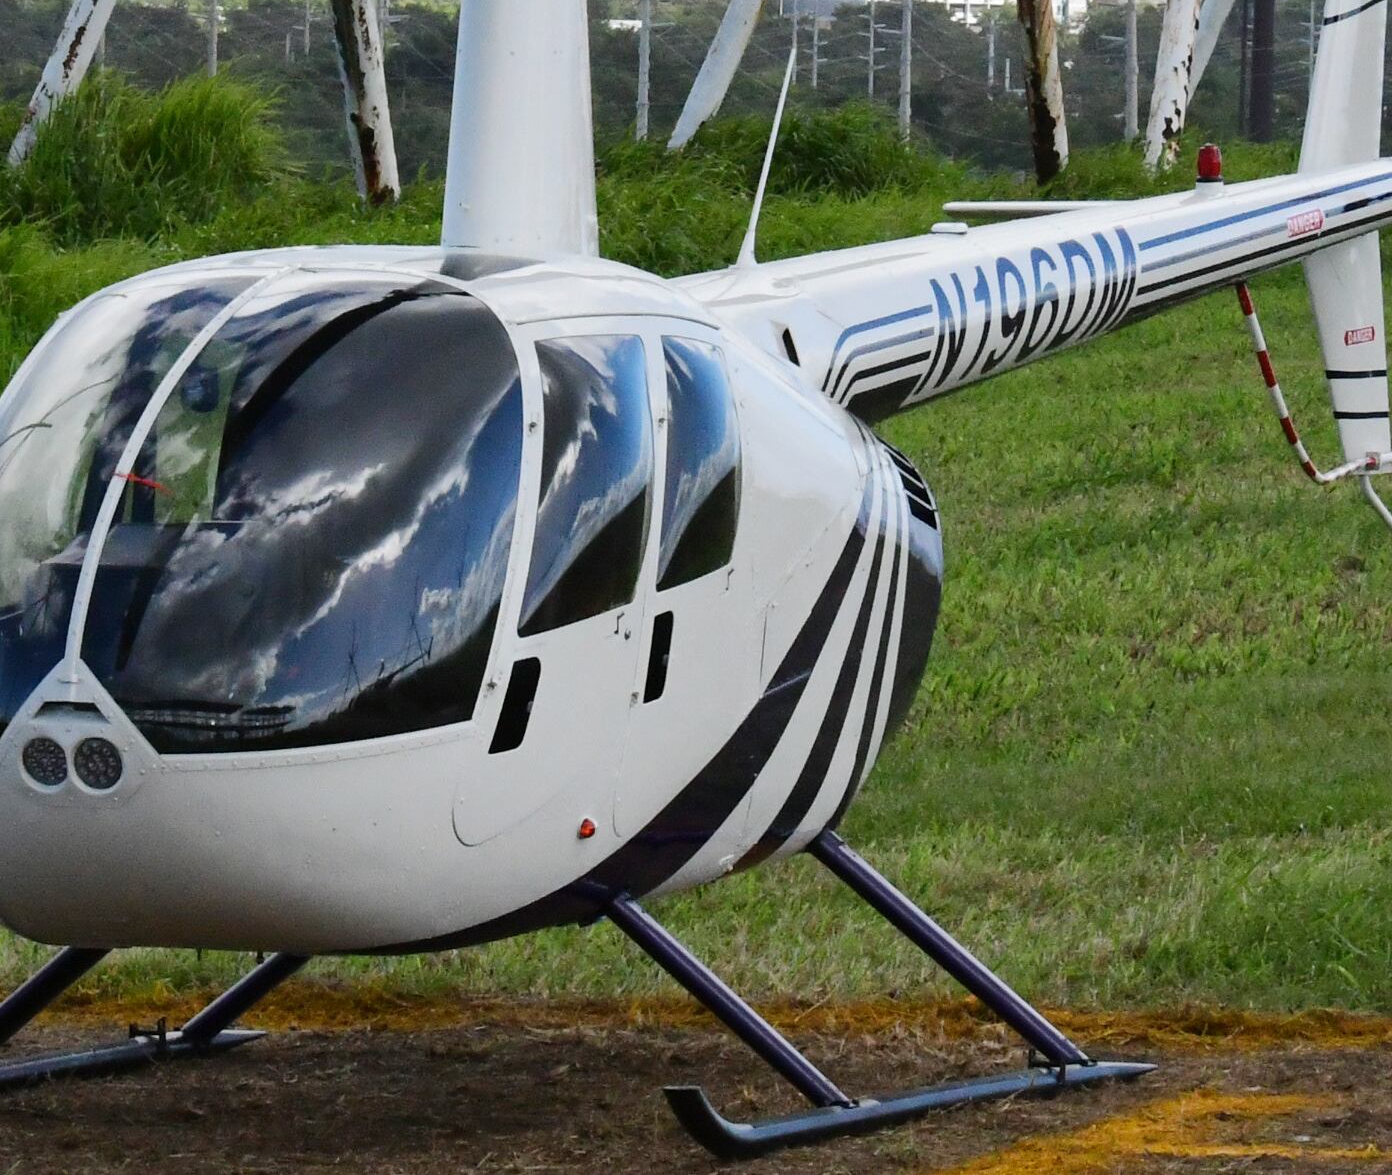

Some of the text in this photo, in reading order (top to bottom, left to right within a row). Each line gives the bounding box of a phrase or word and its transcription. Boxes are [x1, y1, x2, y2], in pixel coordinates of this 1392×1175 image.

[1287, 211, 1320, 236] DANGER
[913, 225, 1137, 395] N196DM
[1347, 328, 1373, 344] DANGER
